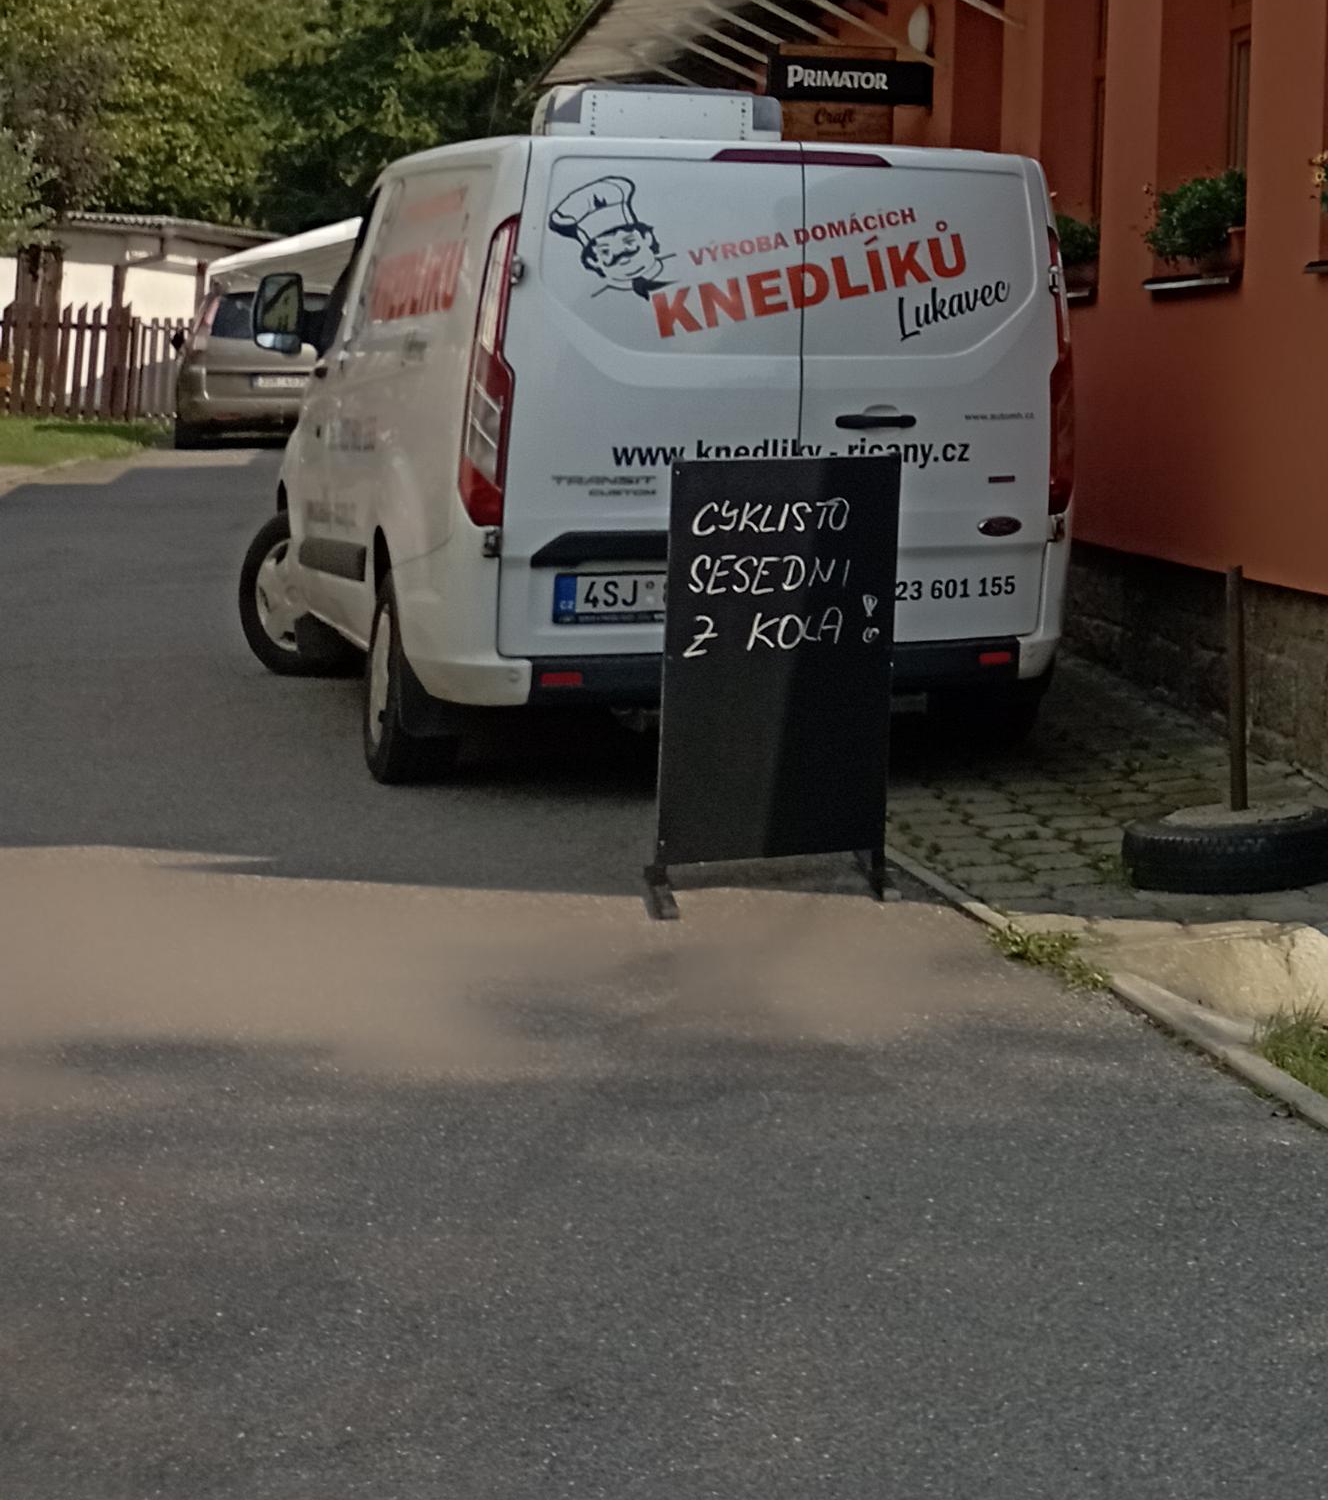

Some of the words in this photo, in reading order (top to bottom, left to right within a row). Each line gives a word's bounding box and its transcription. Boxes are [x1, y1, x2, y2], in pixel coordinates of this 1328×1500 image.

[787, 65, 888, 90] PRIMATOR
[689, 232, 789, 266] VÝROBA
[652, 220, 967, 338] KNEDLÍKŮ
[898, 280, 1010, 341] Lukavec
[552, 475, 656, 485] TRANSIT
[692, 497, 849, 536] CYKLISTO
[688, 555, 850, 594] SESEDNI
[931, 578, 969, 599] 601
[978, 575, 1015, 596] 155
[746, 606, 843, 651] KOLA
